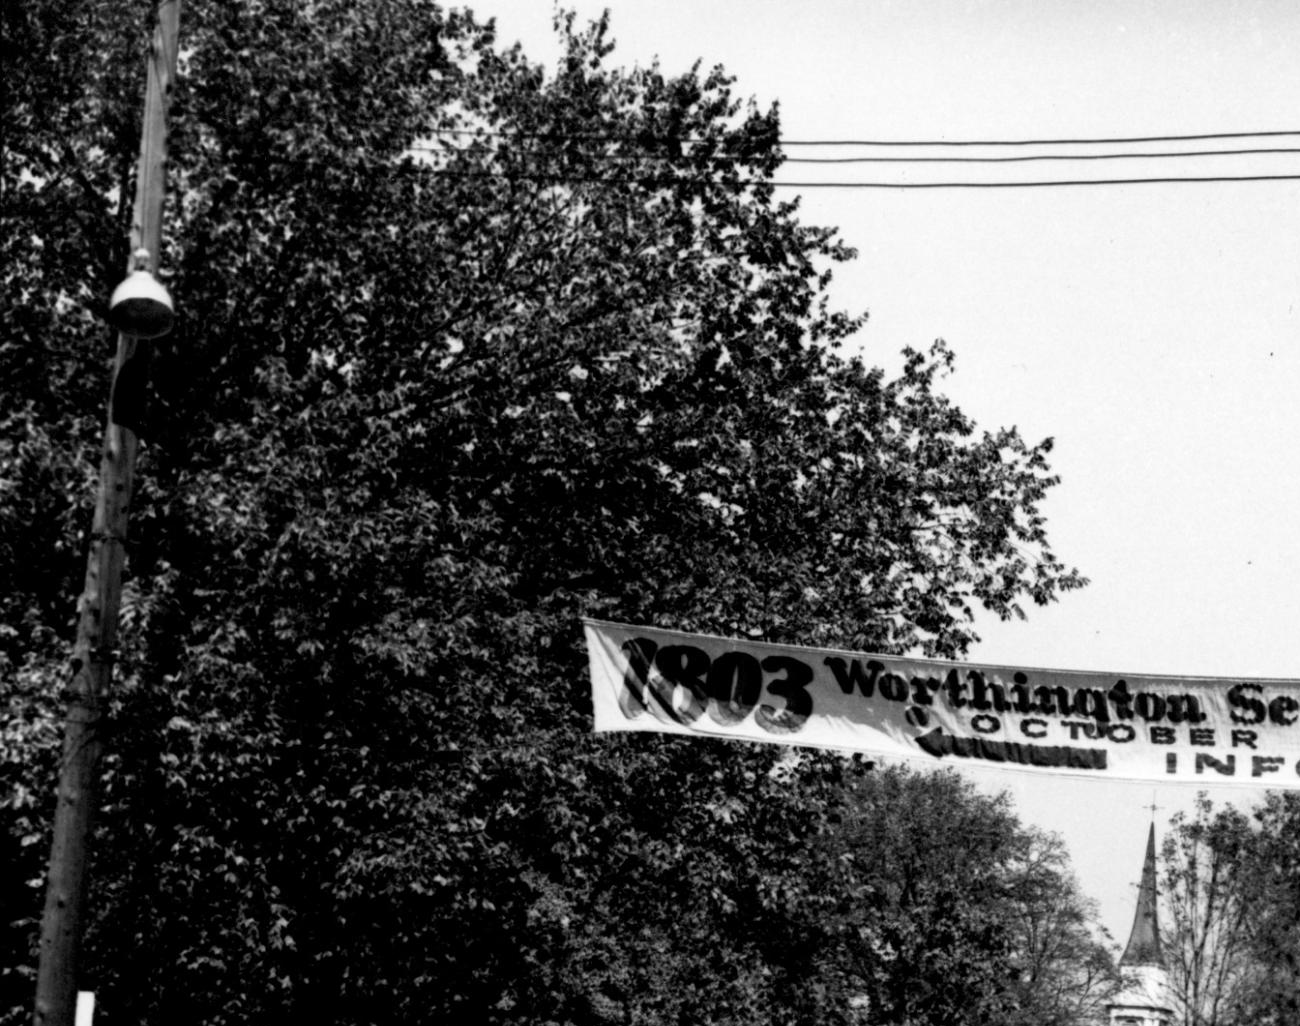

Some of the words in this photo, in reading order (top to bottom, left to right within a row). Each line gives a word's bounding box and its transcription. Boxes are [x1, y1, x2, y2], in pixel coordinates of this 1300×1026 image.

[618, 637, 814, 735] 1803
[823, 656, 1207, 739] Worthington
[970, 714, 1258, 749] OCTOBER
